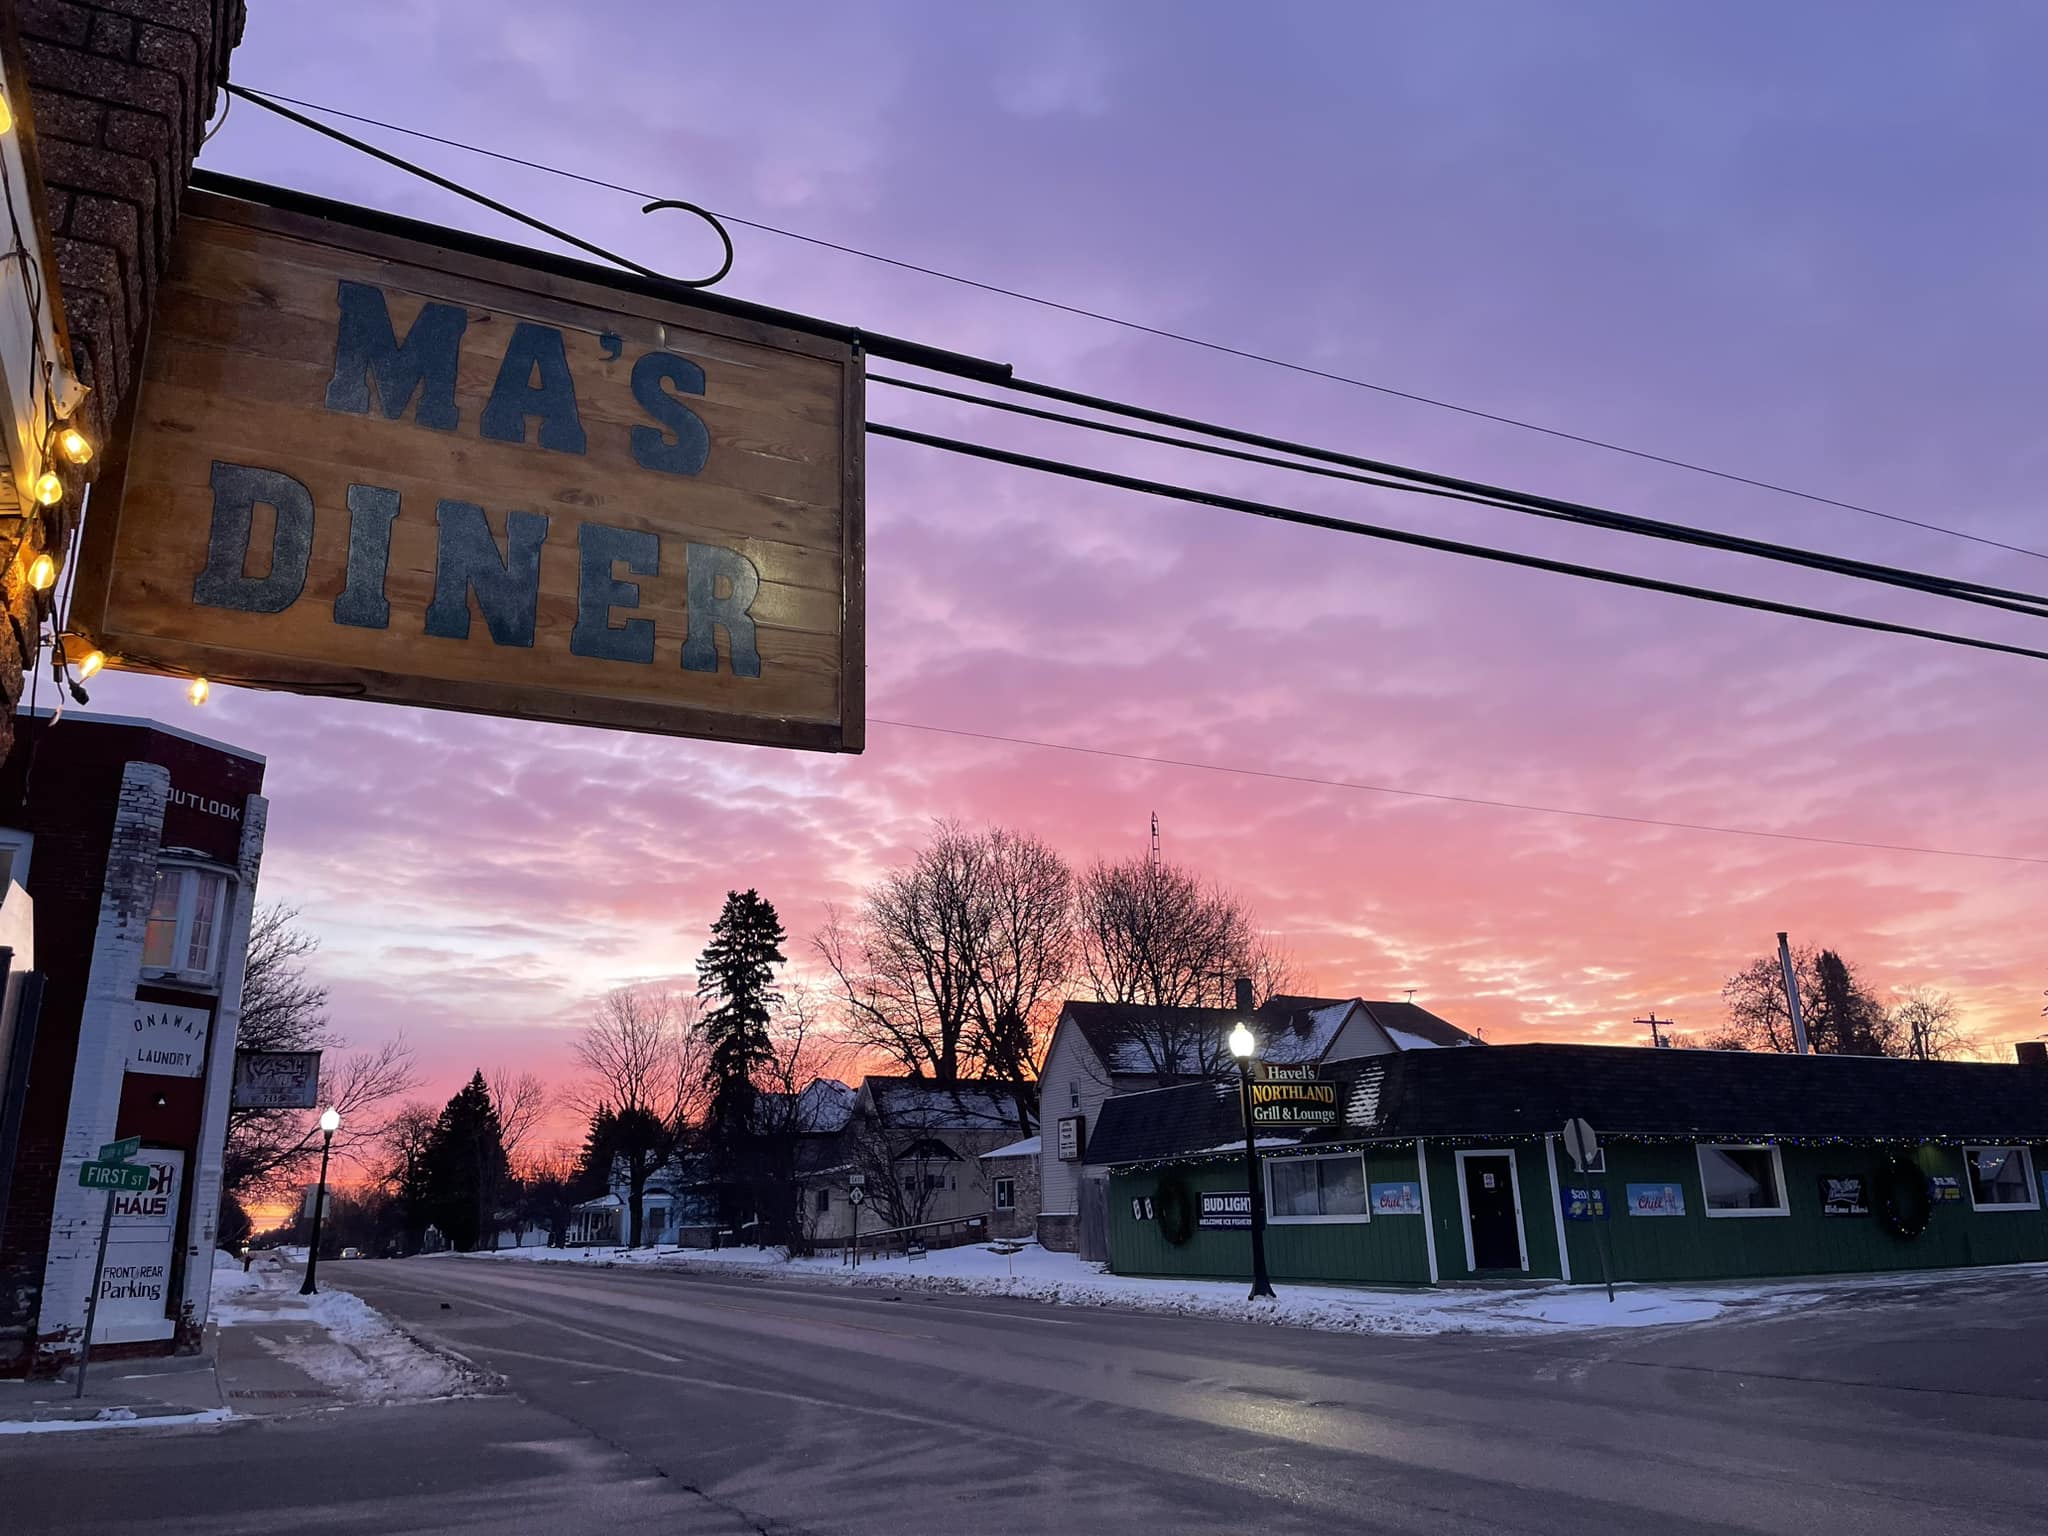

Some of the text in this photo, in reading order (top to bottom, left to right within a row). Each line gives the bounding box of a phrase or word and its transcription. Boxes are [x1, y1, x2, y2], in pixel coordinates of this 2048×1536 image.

[324, 280, 711, 476] MA'S
[193, 459, 761, 678] DINER
[134, 1012, 204, 1040] ONAWAY
[137, 1048, 192, 1066] LAUNDRY
[1267, 1065, 1316, 1080] Havel's
[1252, 1085, 1335, 1105] NORTHLAND
[1254, 1106, 1335, 1123] Grill & Lounge
[87, 1166, 144, 1186] FIRST ST
[114, 1197, 168, 1215] HAUS
[1203, 1197, 1224, 1212] BUD
[103, 1265, 163, 1279] FRONT REAR
[101, 1280, 161, 1301] Parking
